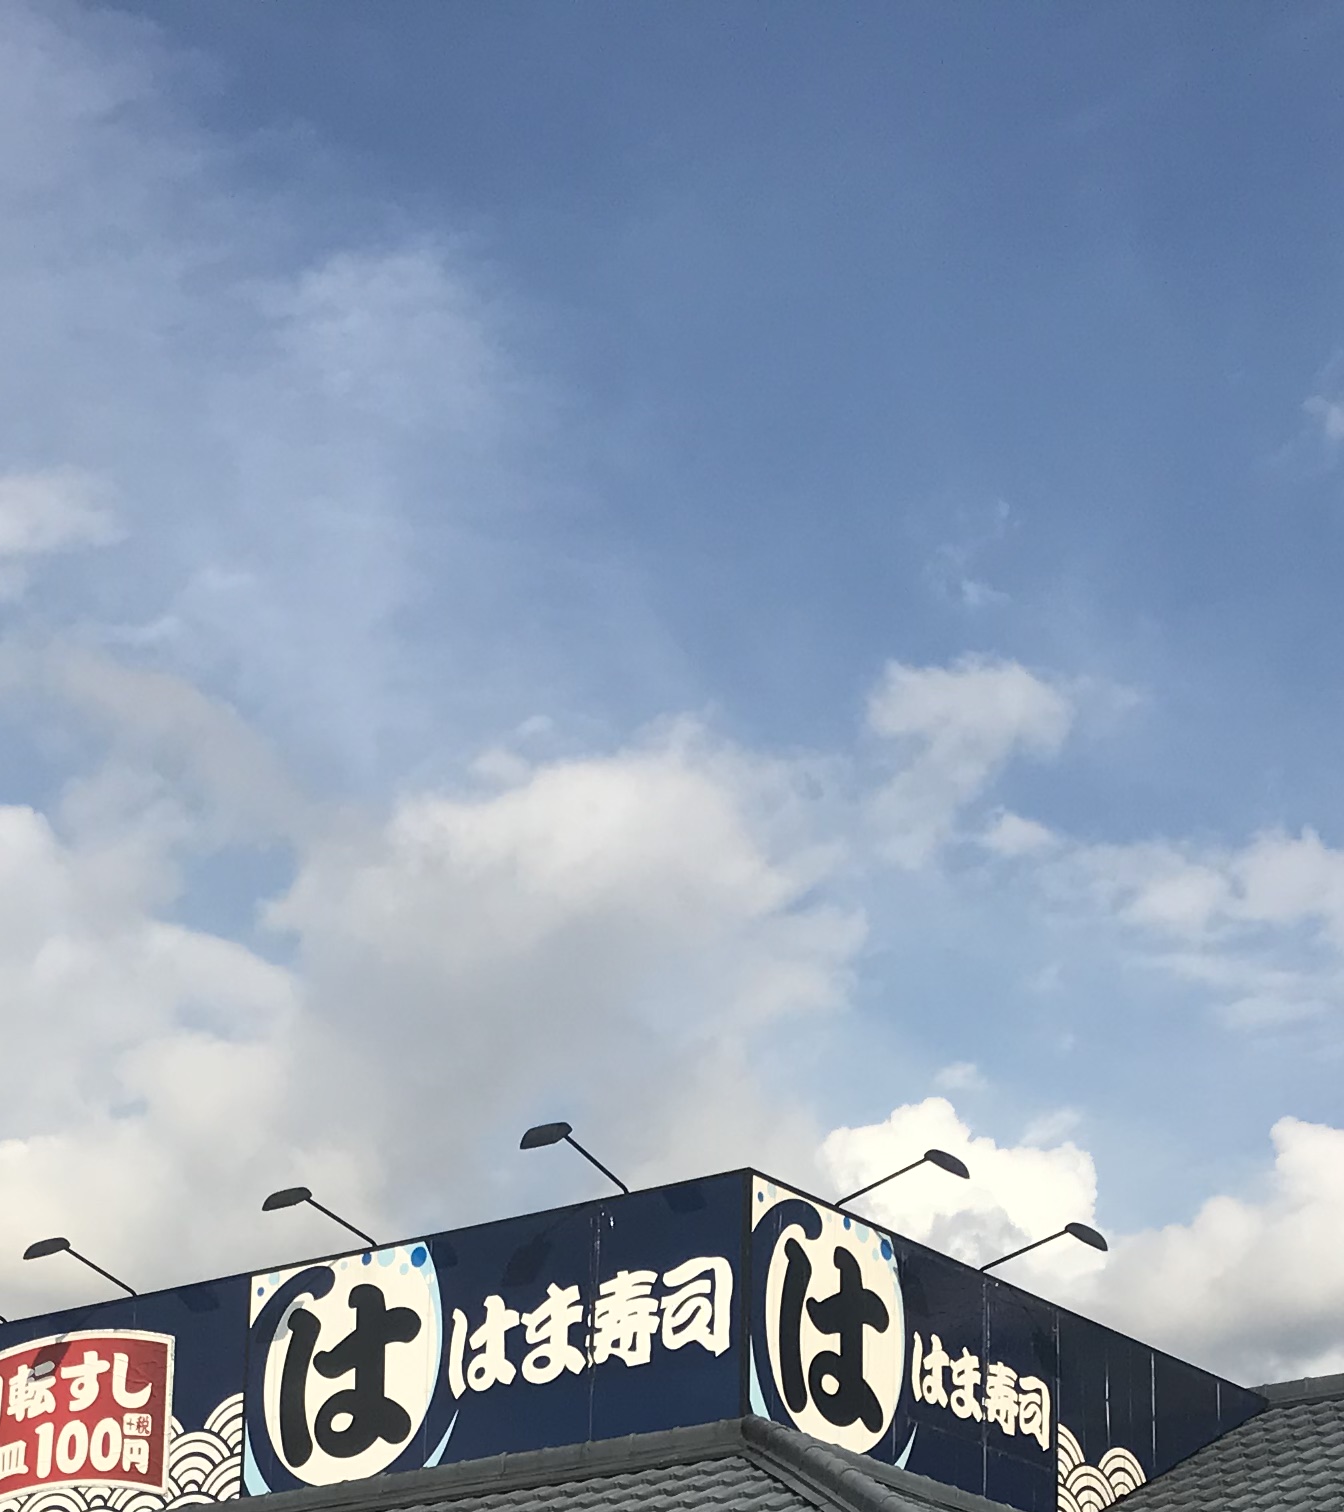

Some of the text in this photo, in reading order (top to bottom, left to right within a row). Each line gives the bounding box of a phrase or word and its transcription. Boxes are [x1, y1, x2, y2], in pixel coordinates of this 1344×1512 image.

[279, 1283, 421, 1467] は
[449, 1256, 733, 1401] はま寿司
[779, 1237, 889, 1433] は
[910, 1330, 1052, 1452] はま寿司
